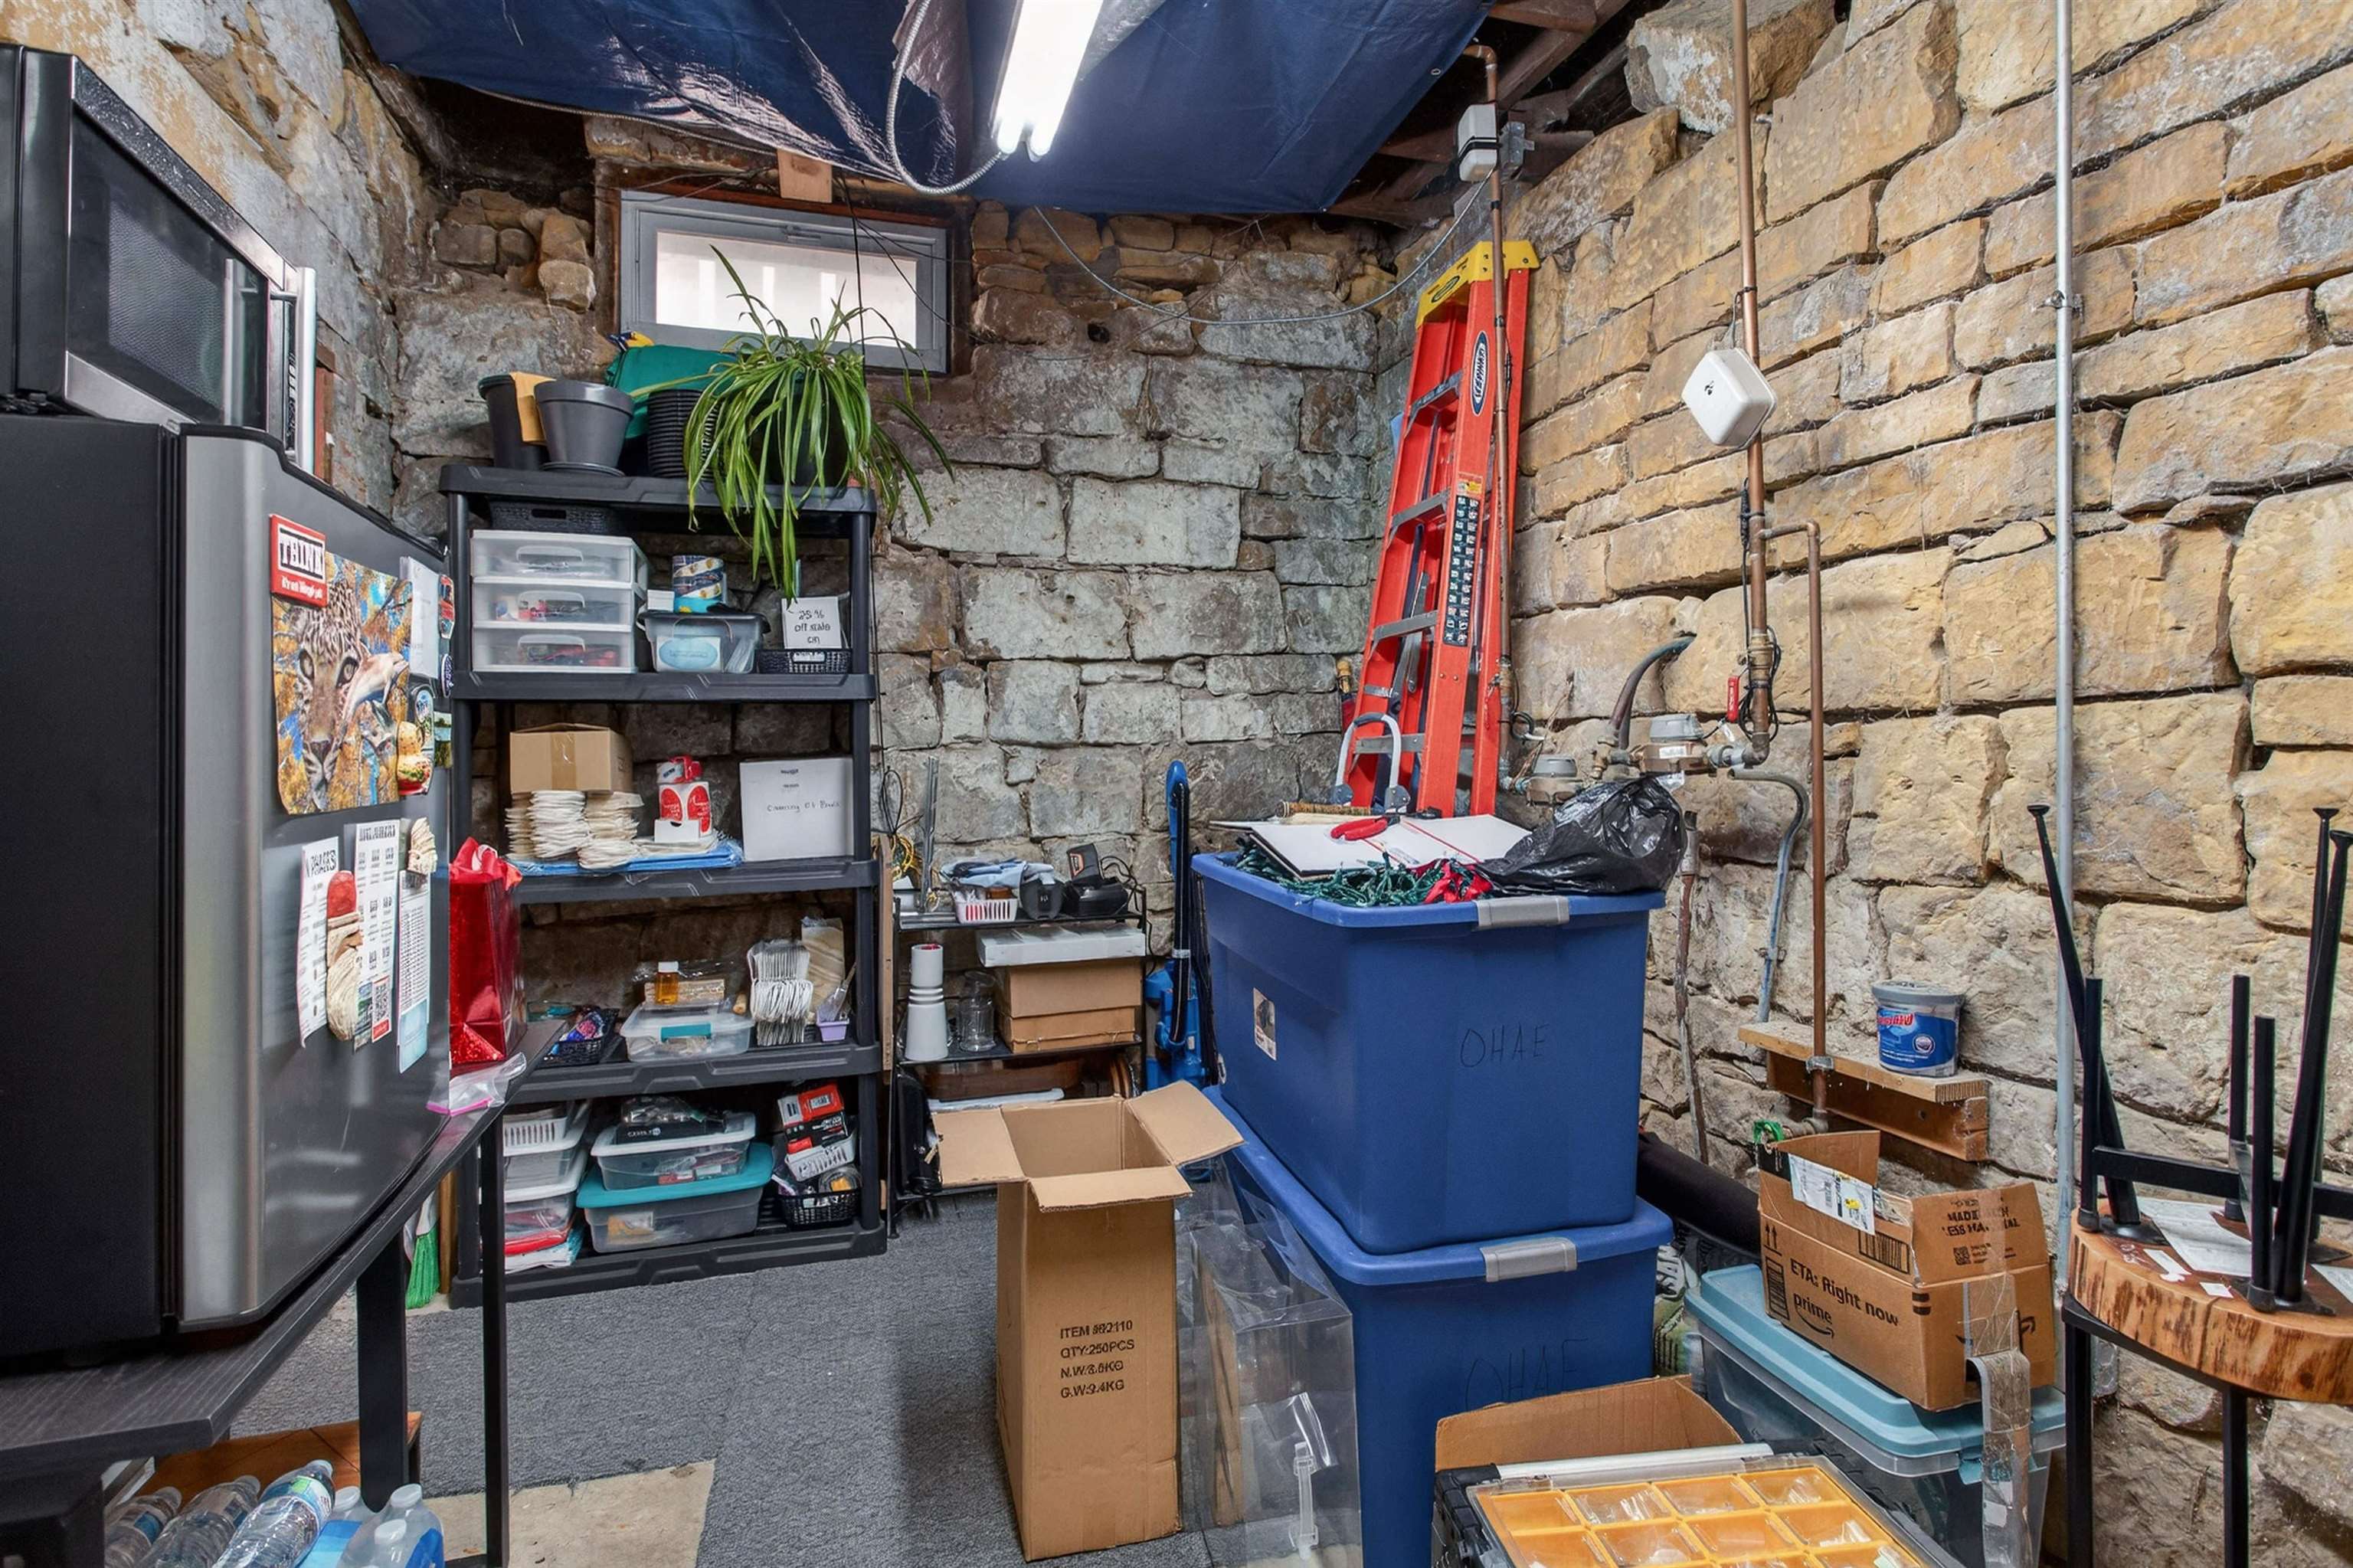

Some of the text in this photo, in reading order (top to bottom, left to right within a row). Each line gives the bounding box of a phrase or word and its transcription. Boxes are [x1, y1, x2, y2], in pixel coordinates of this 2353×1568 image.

[1790, 1258, 1899, 1327] ETA: Right now
[1793, 1293, 1833, 1324] prime
[1060, 1325, 1090, 1340] ITEM
